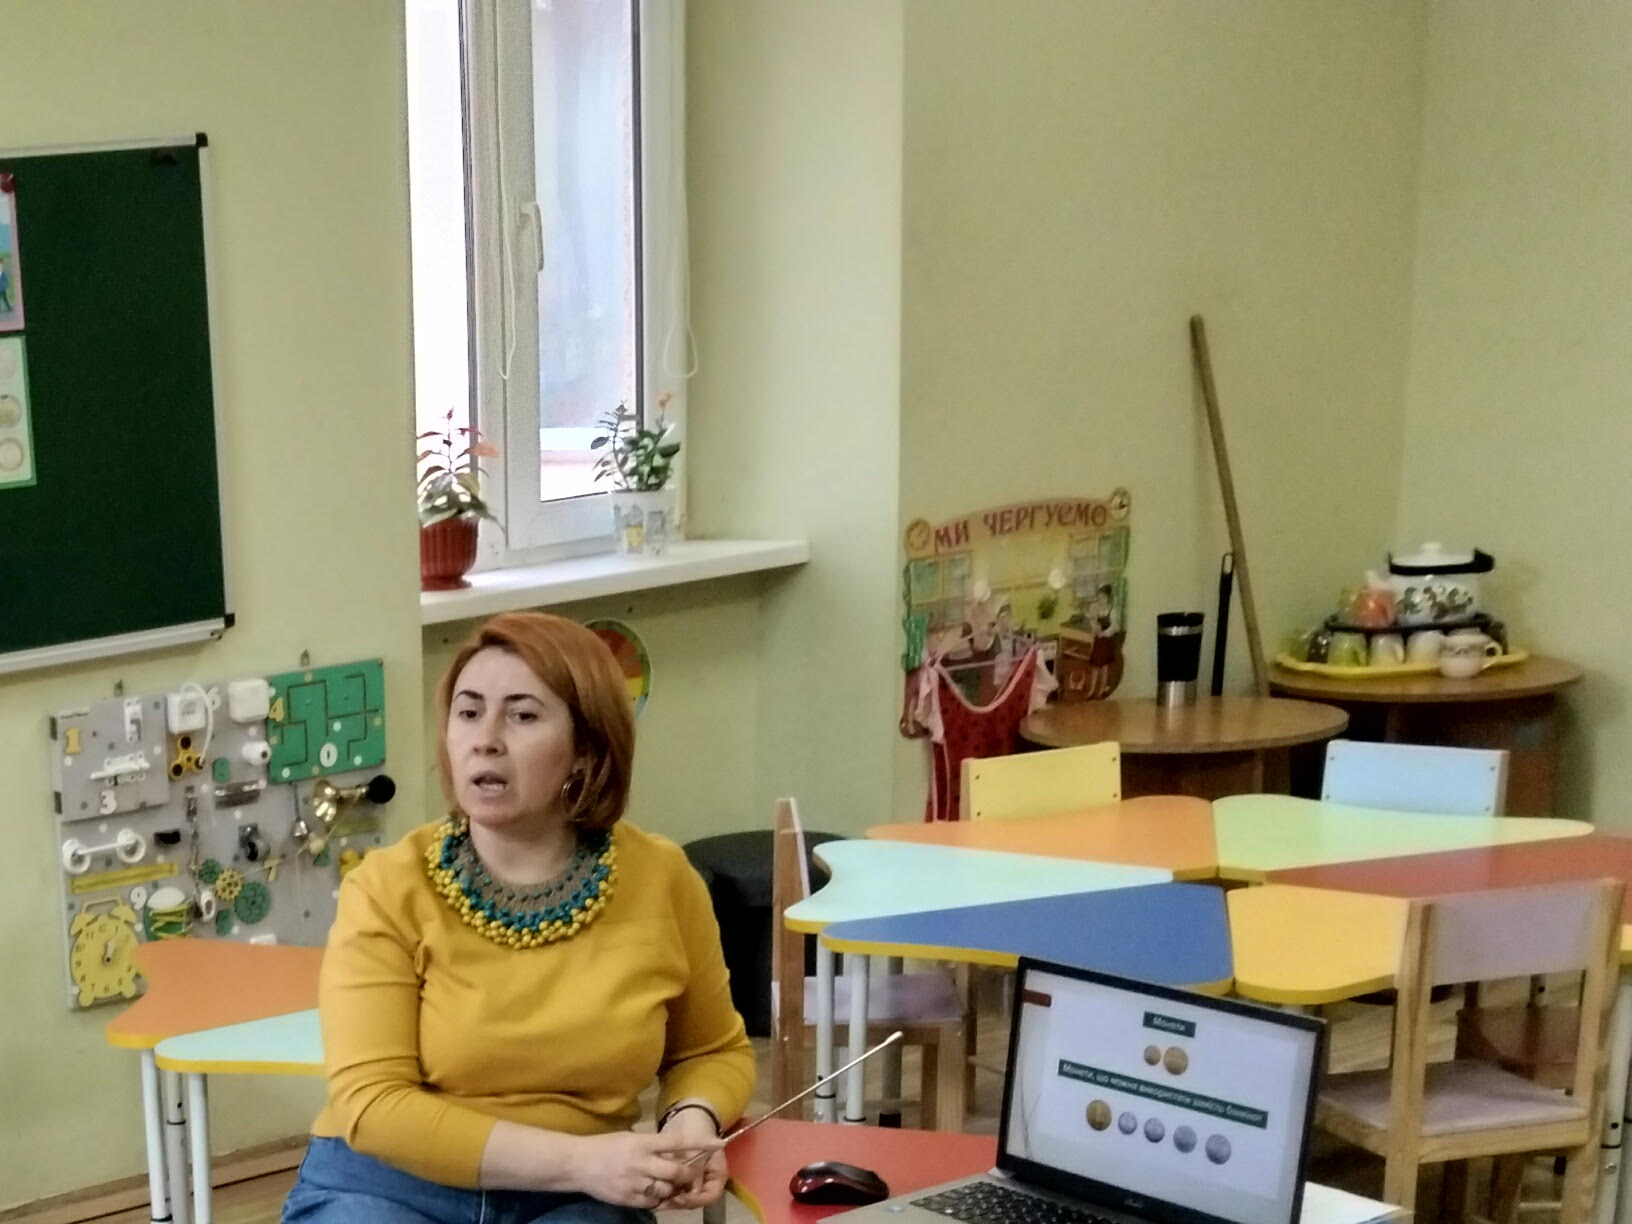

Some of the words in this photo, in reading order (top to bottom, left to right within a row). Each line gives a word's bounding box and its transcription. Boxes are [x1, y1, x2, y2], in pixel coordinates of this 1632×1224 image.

[933, 519, 970, 553] МИ
[983, 502, 1108, 536] ЧЕРГУЄМО
[269, 697, 284, 722] 4
[64, 727, 81, 755] 1
[100, 789, 117, 815] 3
[130, 886, 147, 911] 9
